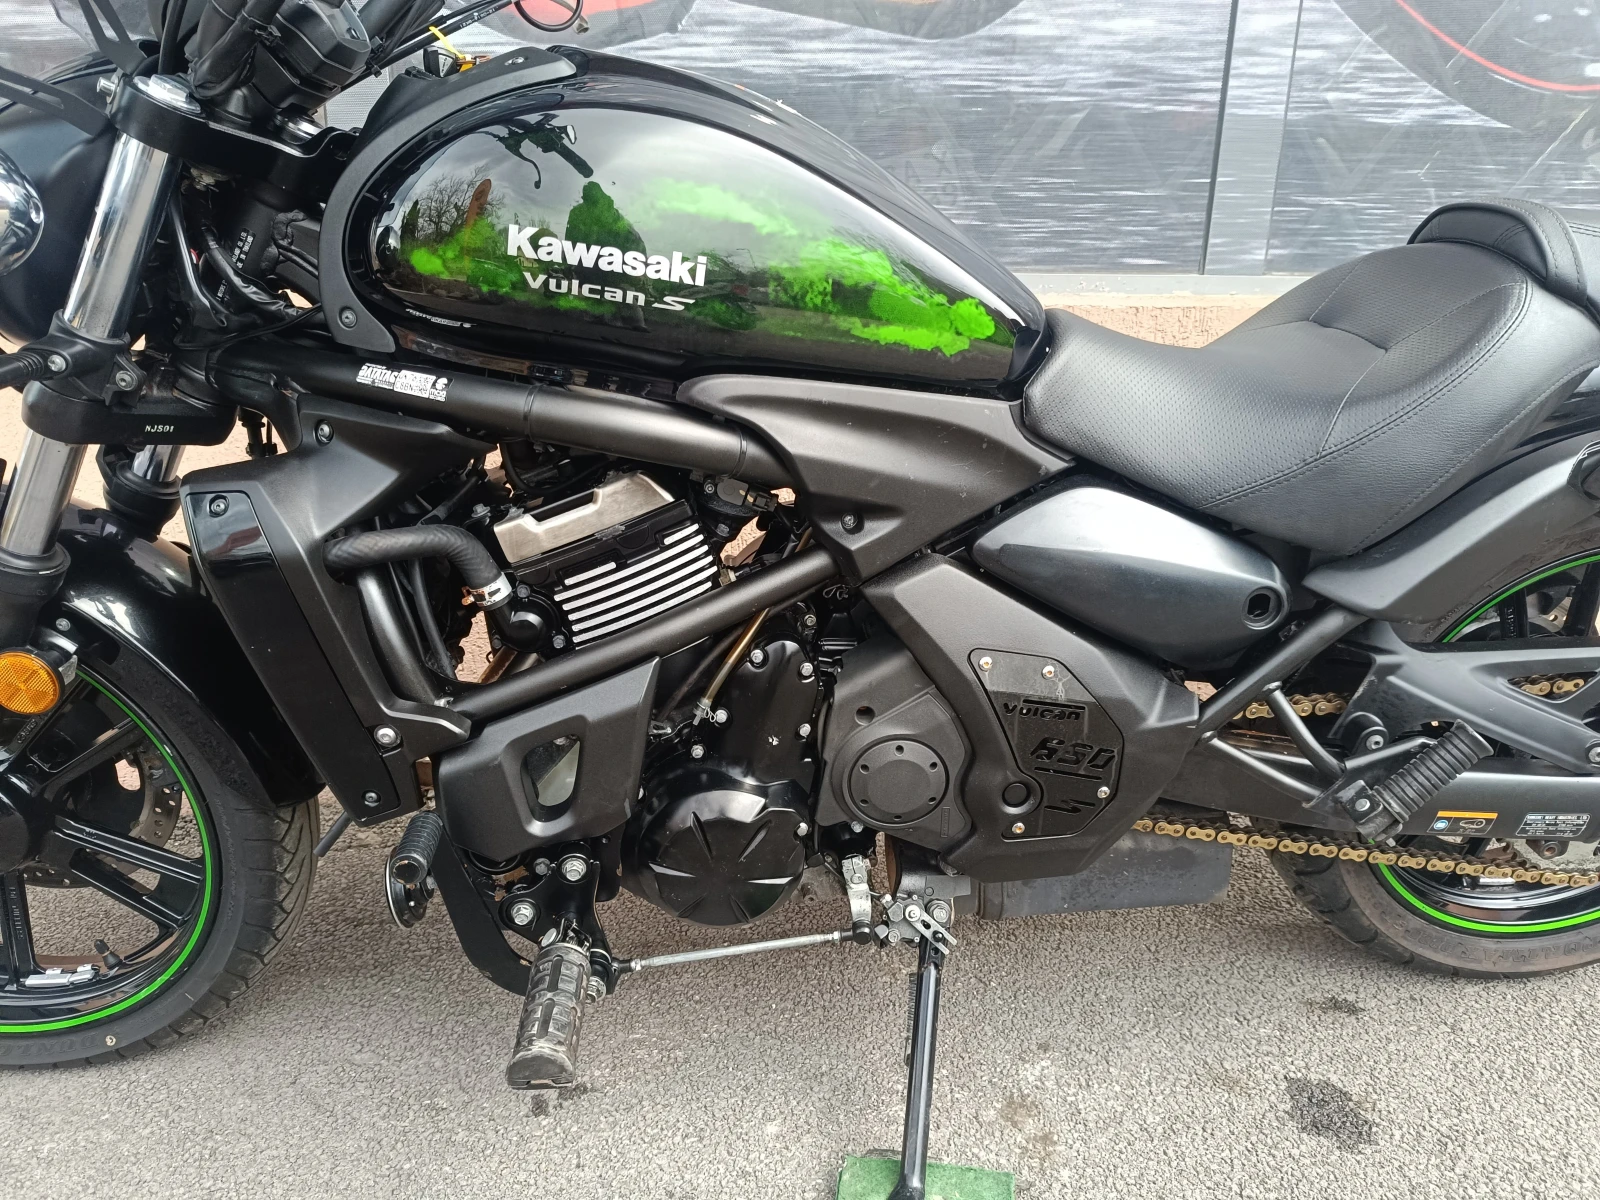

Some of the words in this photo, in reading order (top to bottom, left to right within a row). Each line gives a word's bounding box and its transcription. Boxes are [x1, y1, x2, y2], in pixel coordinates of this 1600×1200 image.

[507, 223, 707, 287] Kawasaki
[651, 295, 696, 311] S
[1029, 736, 1116, 771] 650
[1044, 798, 1096, 815] S
